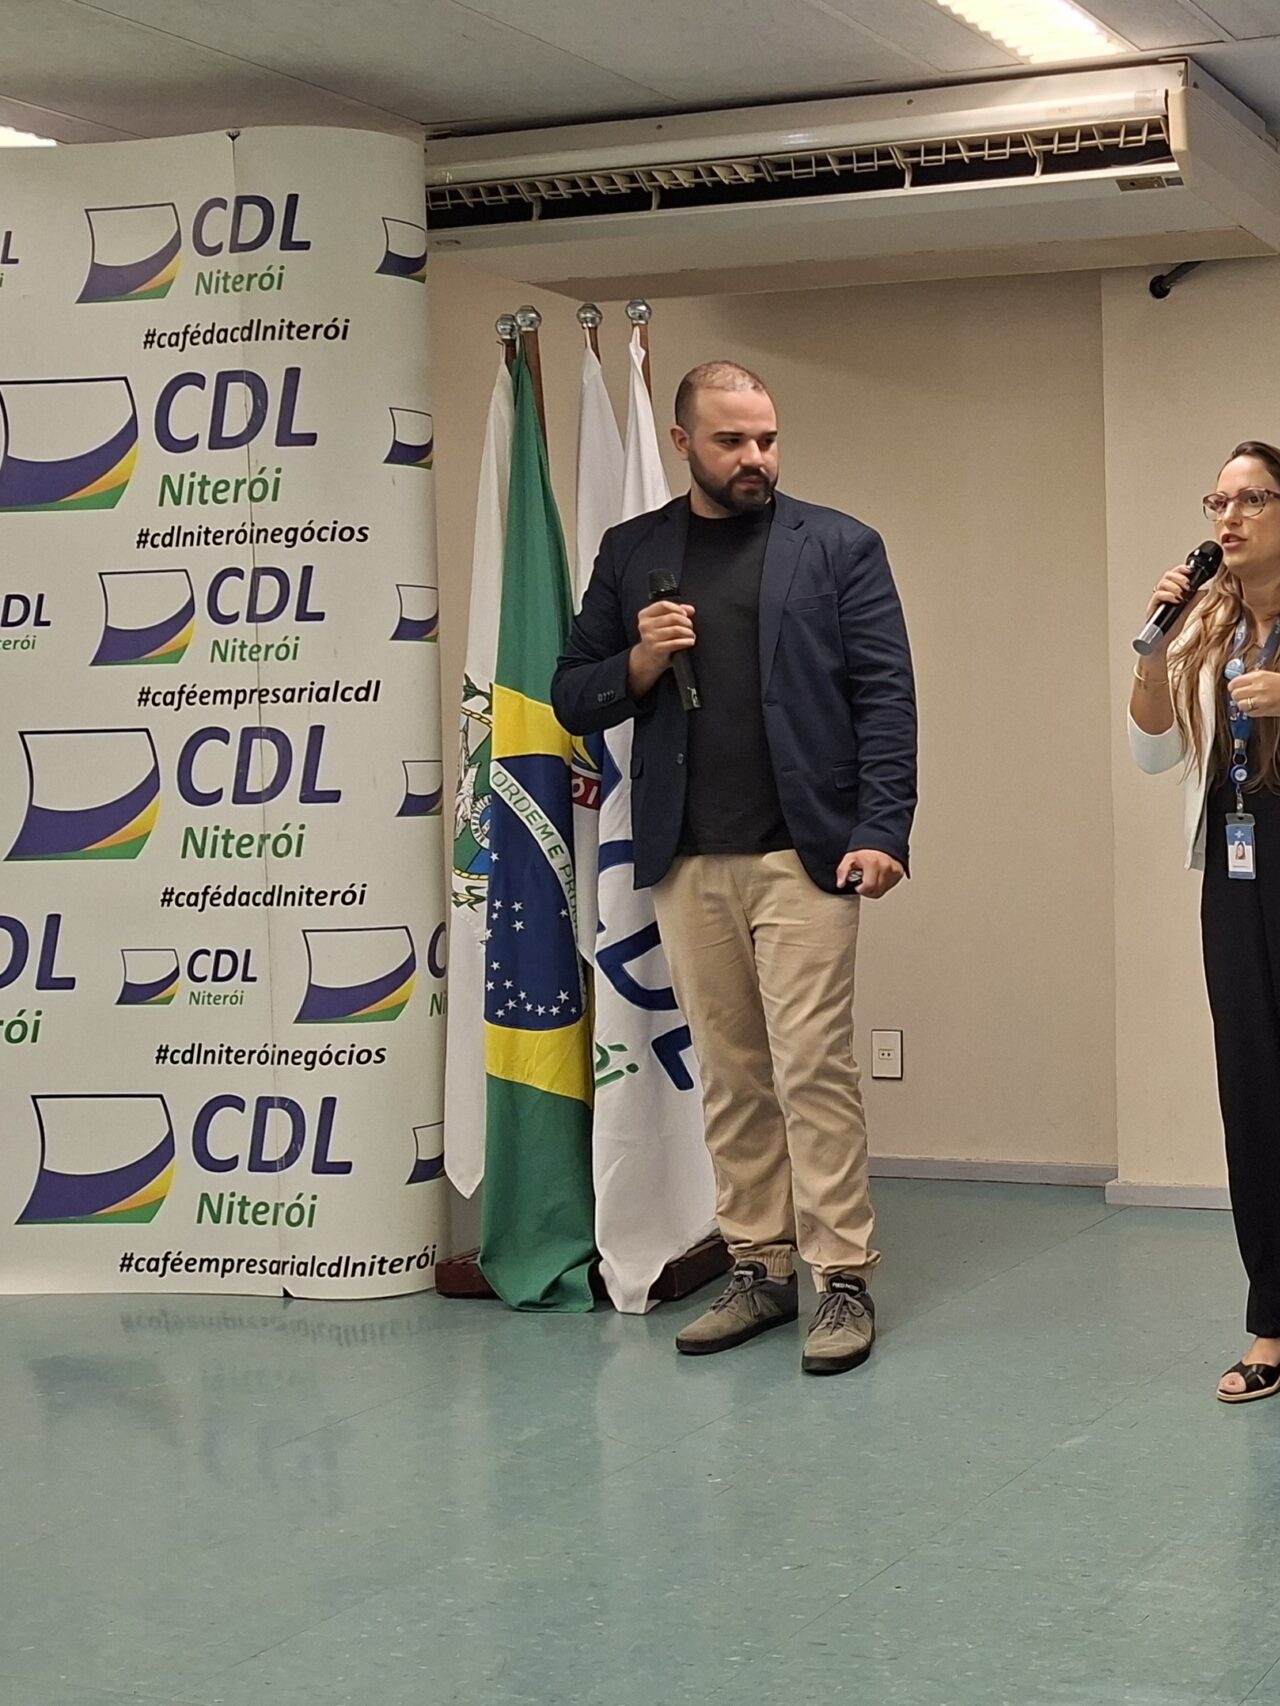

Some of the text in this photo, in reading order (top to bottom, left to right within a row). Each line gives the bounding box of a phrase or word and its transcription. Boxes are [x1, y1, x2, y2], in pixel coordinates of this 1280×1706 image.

[192, 193, 312, 257] CDL
[195, 264, 286, 296] Niterói
[143, 317, 351, 353] #cafédacdlniterói
[154, 367, 318, 453] CDL
[158, 467, 282, 507] Niterói
[136, 519, 370, 549] #cdlniteróinegócios
[1, 593, 51, 627] DL
[206, 564, 326, 626] CDL
[0, 635, 37, 650] erói
[210, 635, 300, 663] Niterói
[137, 679, 381, 712] #caféempresarialcdl
[176, 724, 342, 807] CDL
[180, 822, 306, 859] Niterói
[160, 882, 368, 913] #cafédacdlniterói
[186, 948, 258, 983] CDL
[188, 989, 244, 1006] Niterói
[155, 1042, 387, 1071] #cdlniteróinegócios
[191, 1094, 353, 1175] CDL
[196, 1191, 318, 1228] Niterói
[119, 1244, 437, 1278] #caféempresarialcdlniterói
